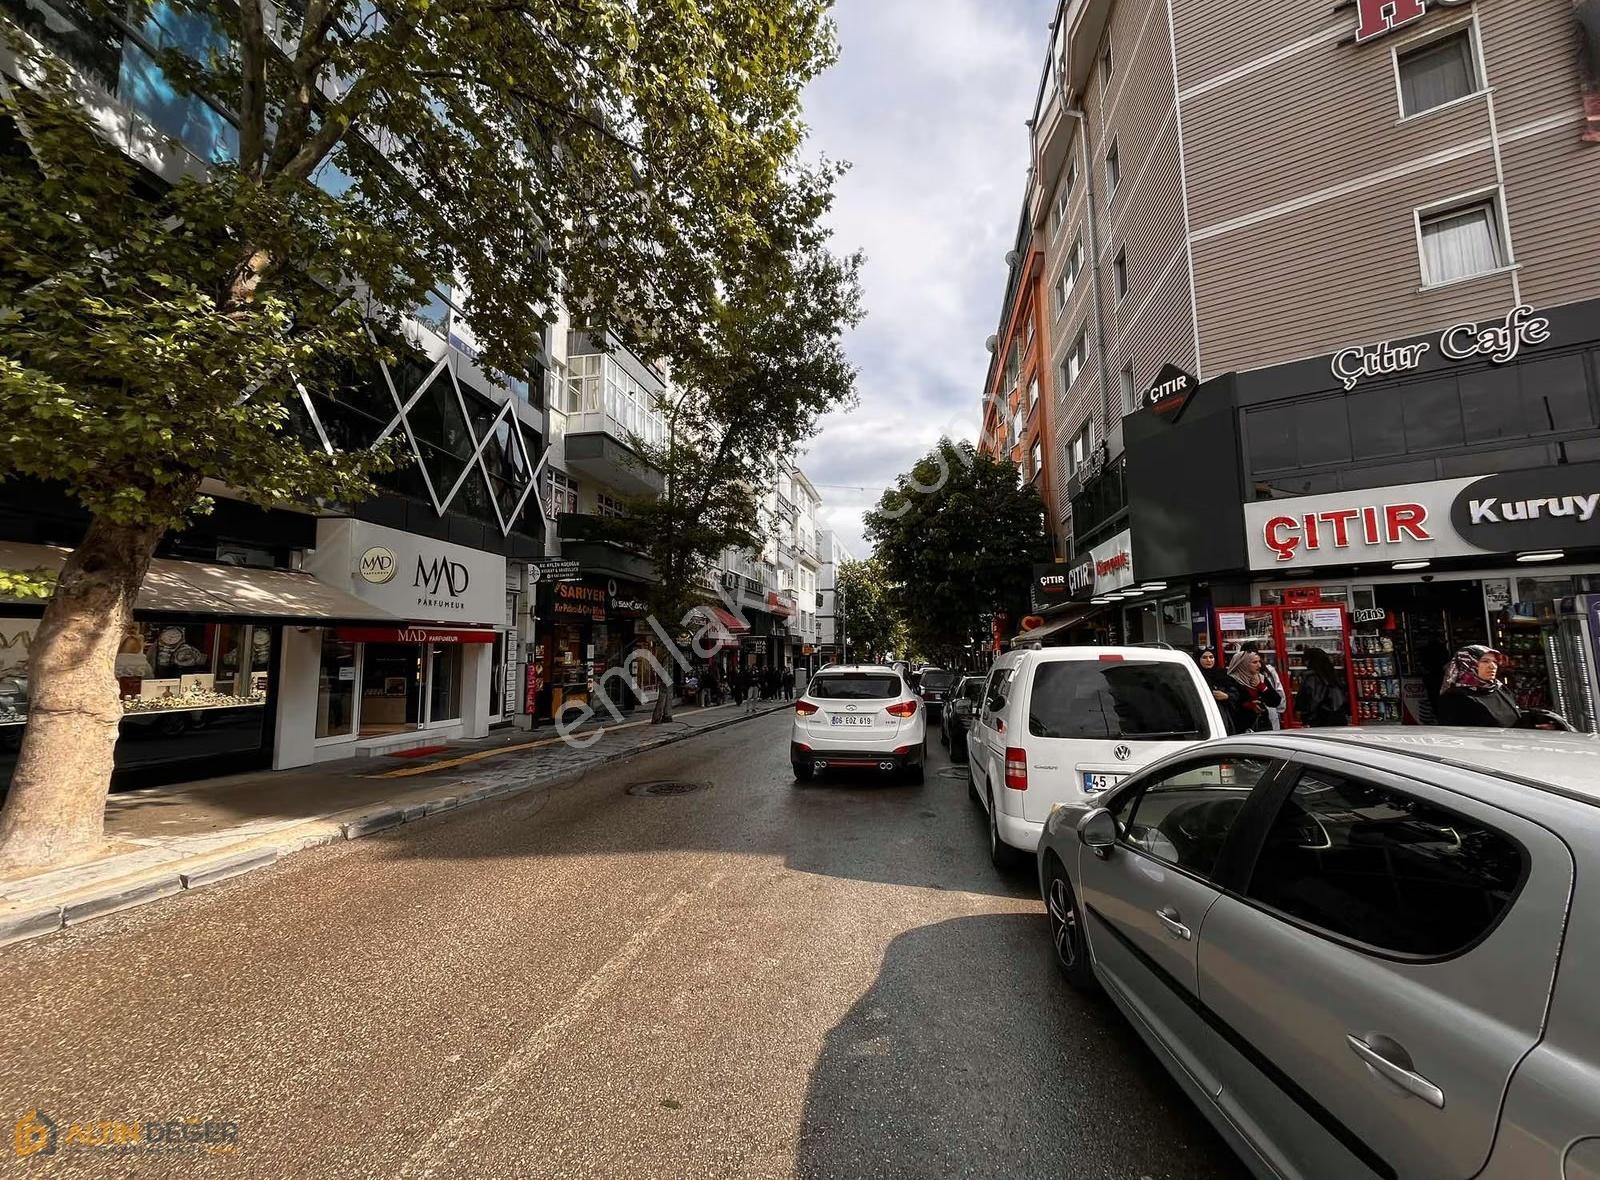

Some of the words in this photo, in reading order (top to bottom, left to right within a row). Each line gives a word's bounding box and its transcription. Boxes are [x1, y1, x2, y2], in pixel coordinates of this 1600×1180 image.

[1330, 341, 1430, 391] Çıtır
[1440, 305, 1551, 363] Cafe
[1150, 375, 1188, 404] ÇITIR
[1263, 502, 1435, 561] ÇITIR
[362, 555, 392, 571] MAD
[412, 553, 469, 598] MAD
[1040, 575, 1065, 586] ÇITIR
[1068, 562, 1090, 597] ÇITIR
[560, 584, 606, 601] SARIYER
[417, 598, 465, 609] PARFUMEUR
[398, 629, 427, 642] MAD
[859, 717, 871, 725] 619
[1092, 775, 1107, 788] 45
